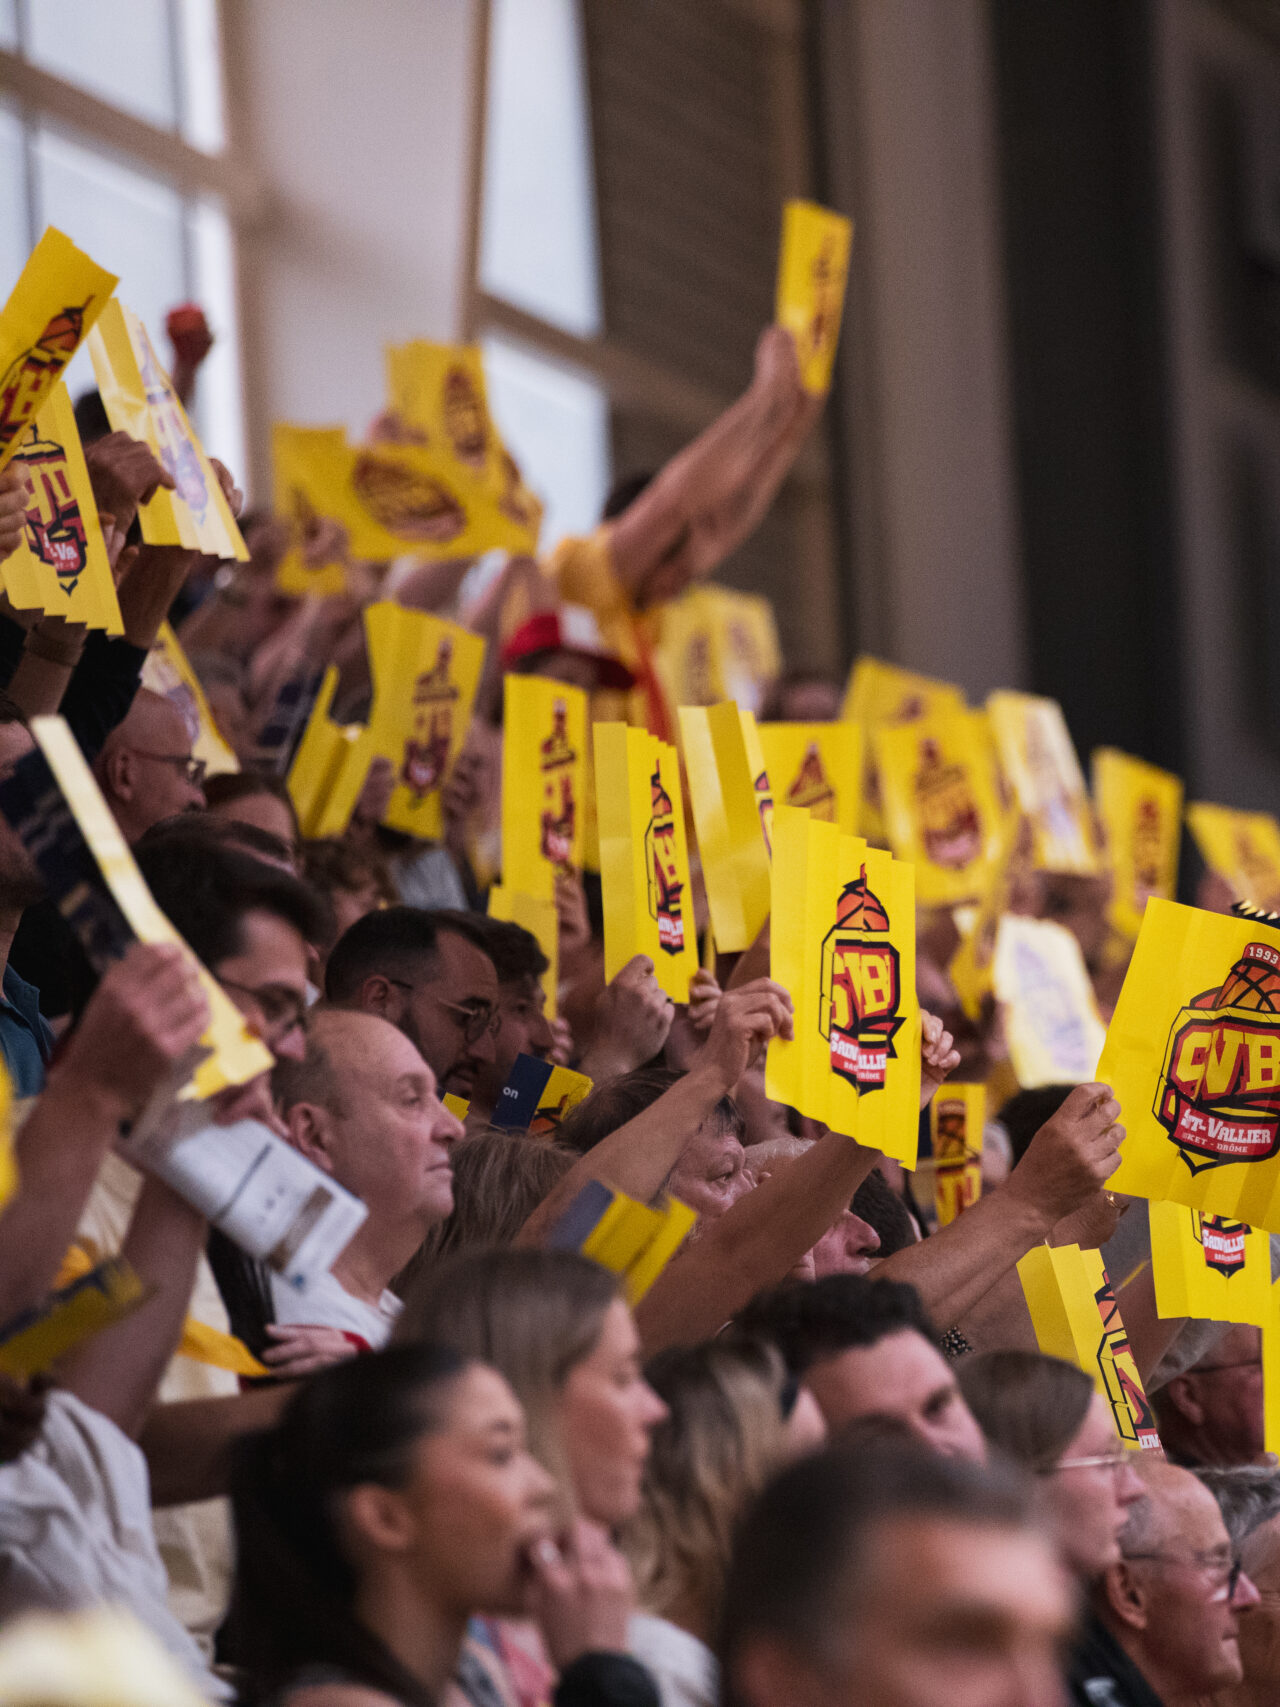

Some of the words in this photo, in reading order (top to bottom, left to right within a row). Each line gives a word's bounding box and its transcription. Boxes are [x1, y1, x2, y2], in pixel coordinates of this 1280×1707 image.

[1249, 946, 1280, 965] 1993
[1182, 1132, 1208, 1146] KET
[1216, 1143, 1249, 1153] DRÔME
